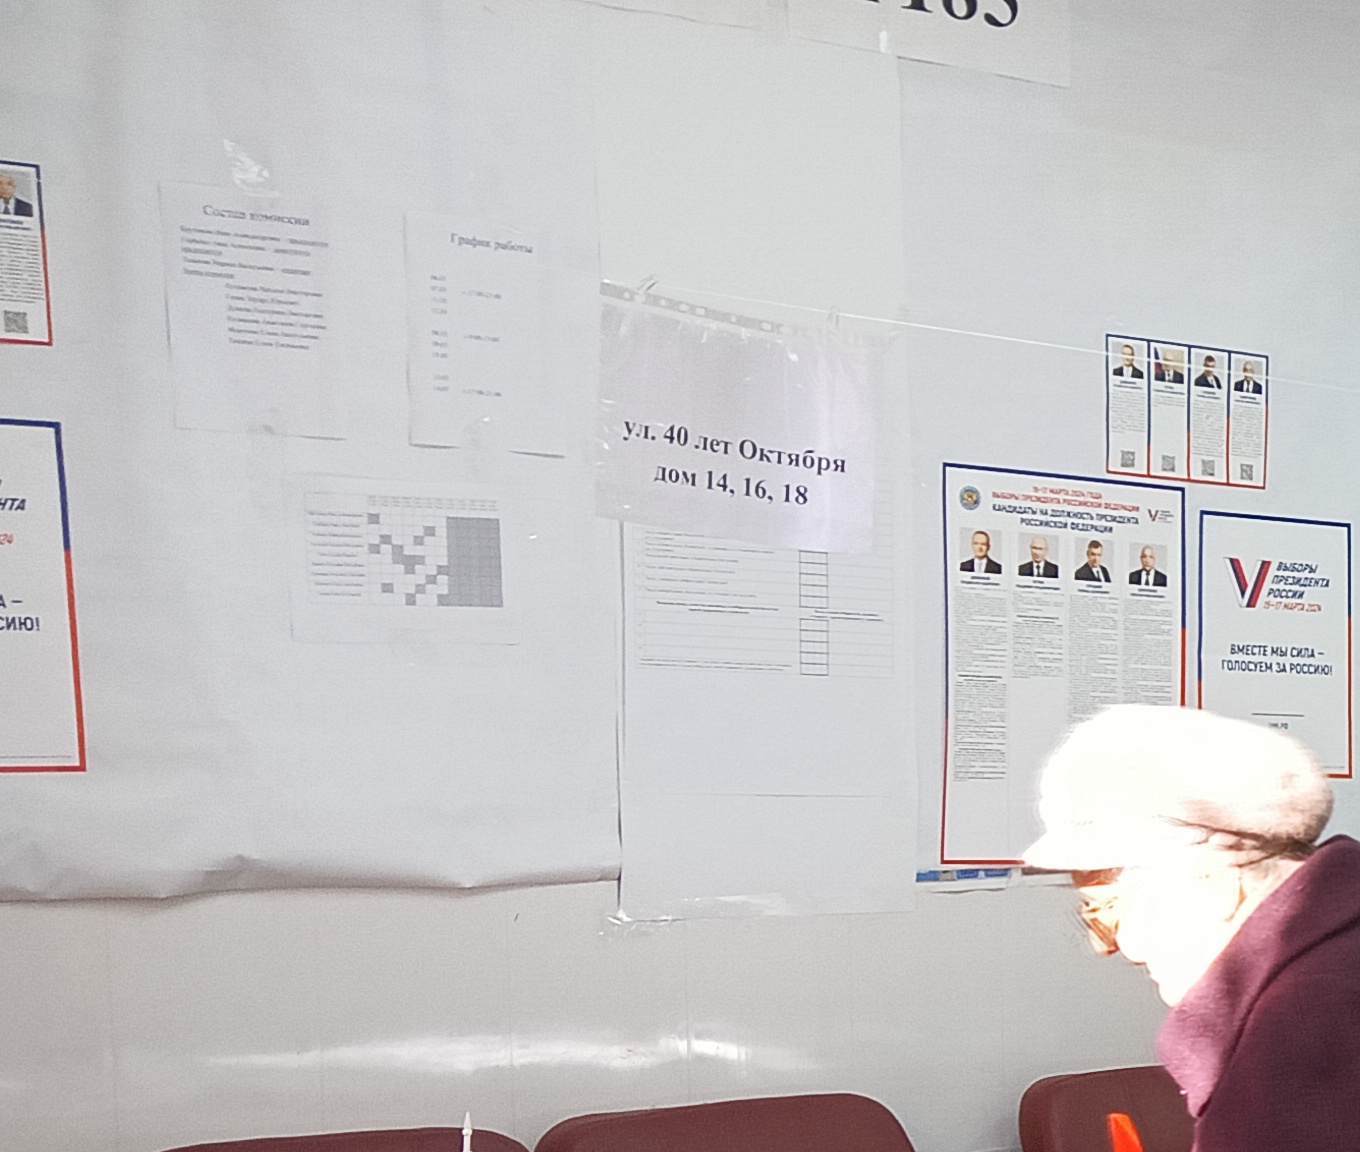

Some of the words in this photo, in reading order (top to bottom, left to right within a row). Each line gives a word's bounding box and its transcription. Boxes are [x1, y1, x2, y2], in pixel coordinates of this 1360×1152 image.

[623, 420, 656, 441] ул.
[663, 424, 689, 447] 40
[694, 436, 732, 455] лет
[739, 439, 846, 476] Октября
[653, 465, 697, 487] дом
[706, 470, 735, 497] 14,
[743, 477, 773, 503] 16,
[783, 483, 808, 505] 18
[1276, 562, 1318, 573] ВЫБОРЫ
[1271, 575, 1330, 588] ПРЕЗИДЕНТА
[1267, 588, 1305, 600] РОССИИ
[1230, 643, 1268, 656] ВМЕСТЕ
[1271, 645, 1287, 658] МЫ
[1290, 647, 1315, 658] СИЛА
[1221, 659, 1273, 673] ГОЛОСУЕМ
[1275, 662, 1287, 673] ЗА
[1289, 662, 1332, 676] РОССИЮ!
